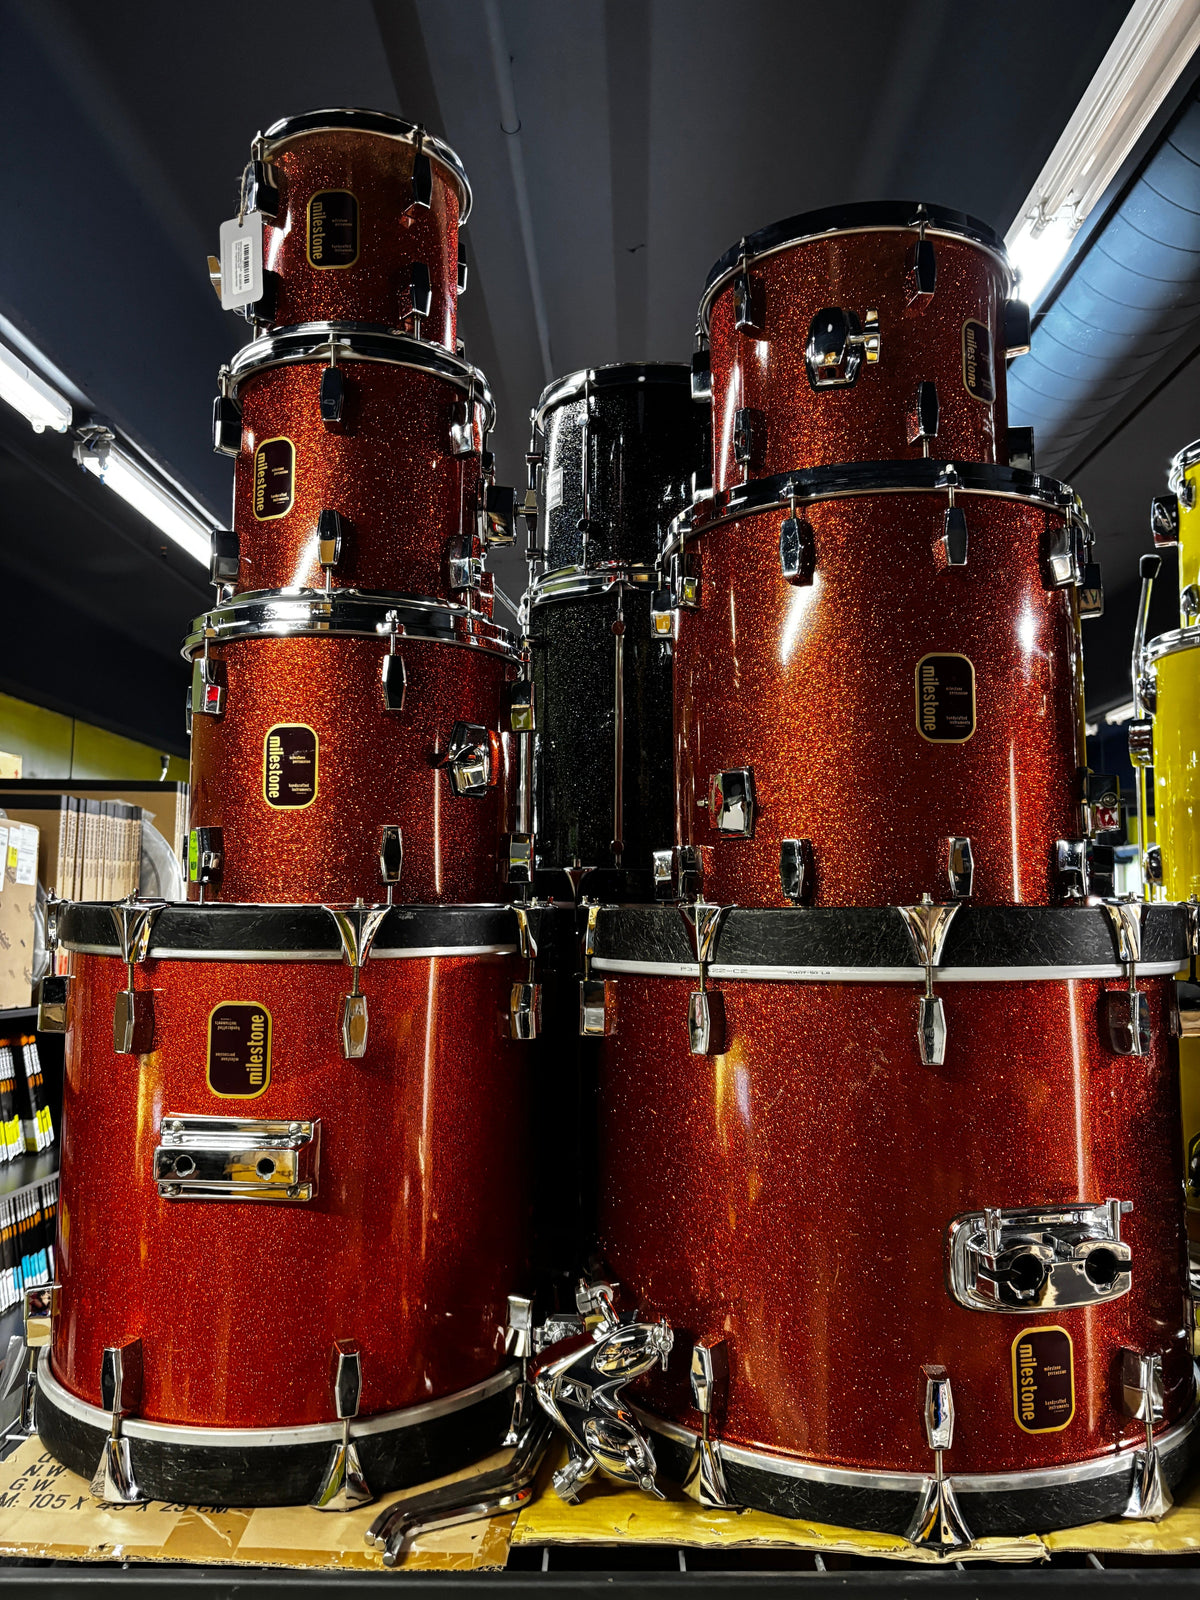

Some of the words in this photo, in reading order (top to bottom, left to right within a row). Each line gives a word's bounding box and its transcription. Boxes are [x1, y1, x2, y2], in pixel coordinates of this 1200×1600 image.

[312, 201, 327, 260] milestone
[966, 328, 978, 388] milestone
[256, 452, 268, 512] milestone
[922, 665, 940, 731] milestone
[268, 735, 284, 798] milestone
[245, 1014, 265, 1085] milestone
[1019, 1344, 1038, 1421] milestone
[29, 1493, 71, 1509] 105
